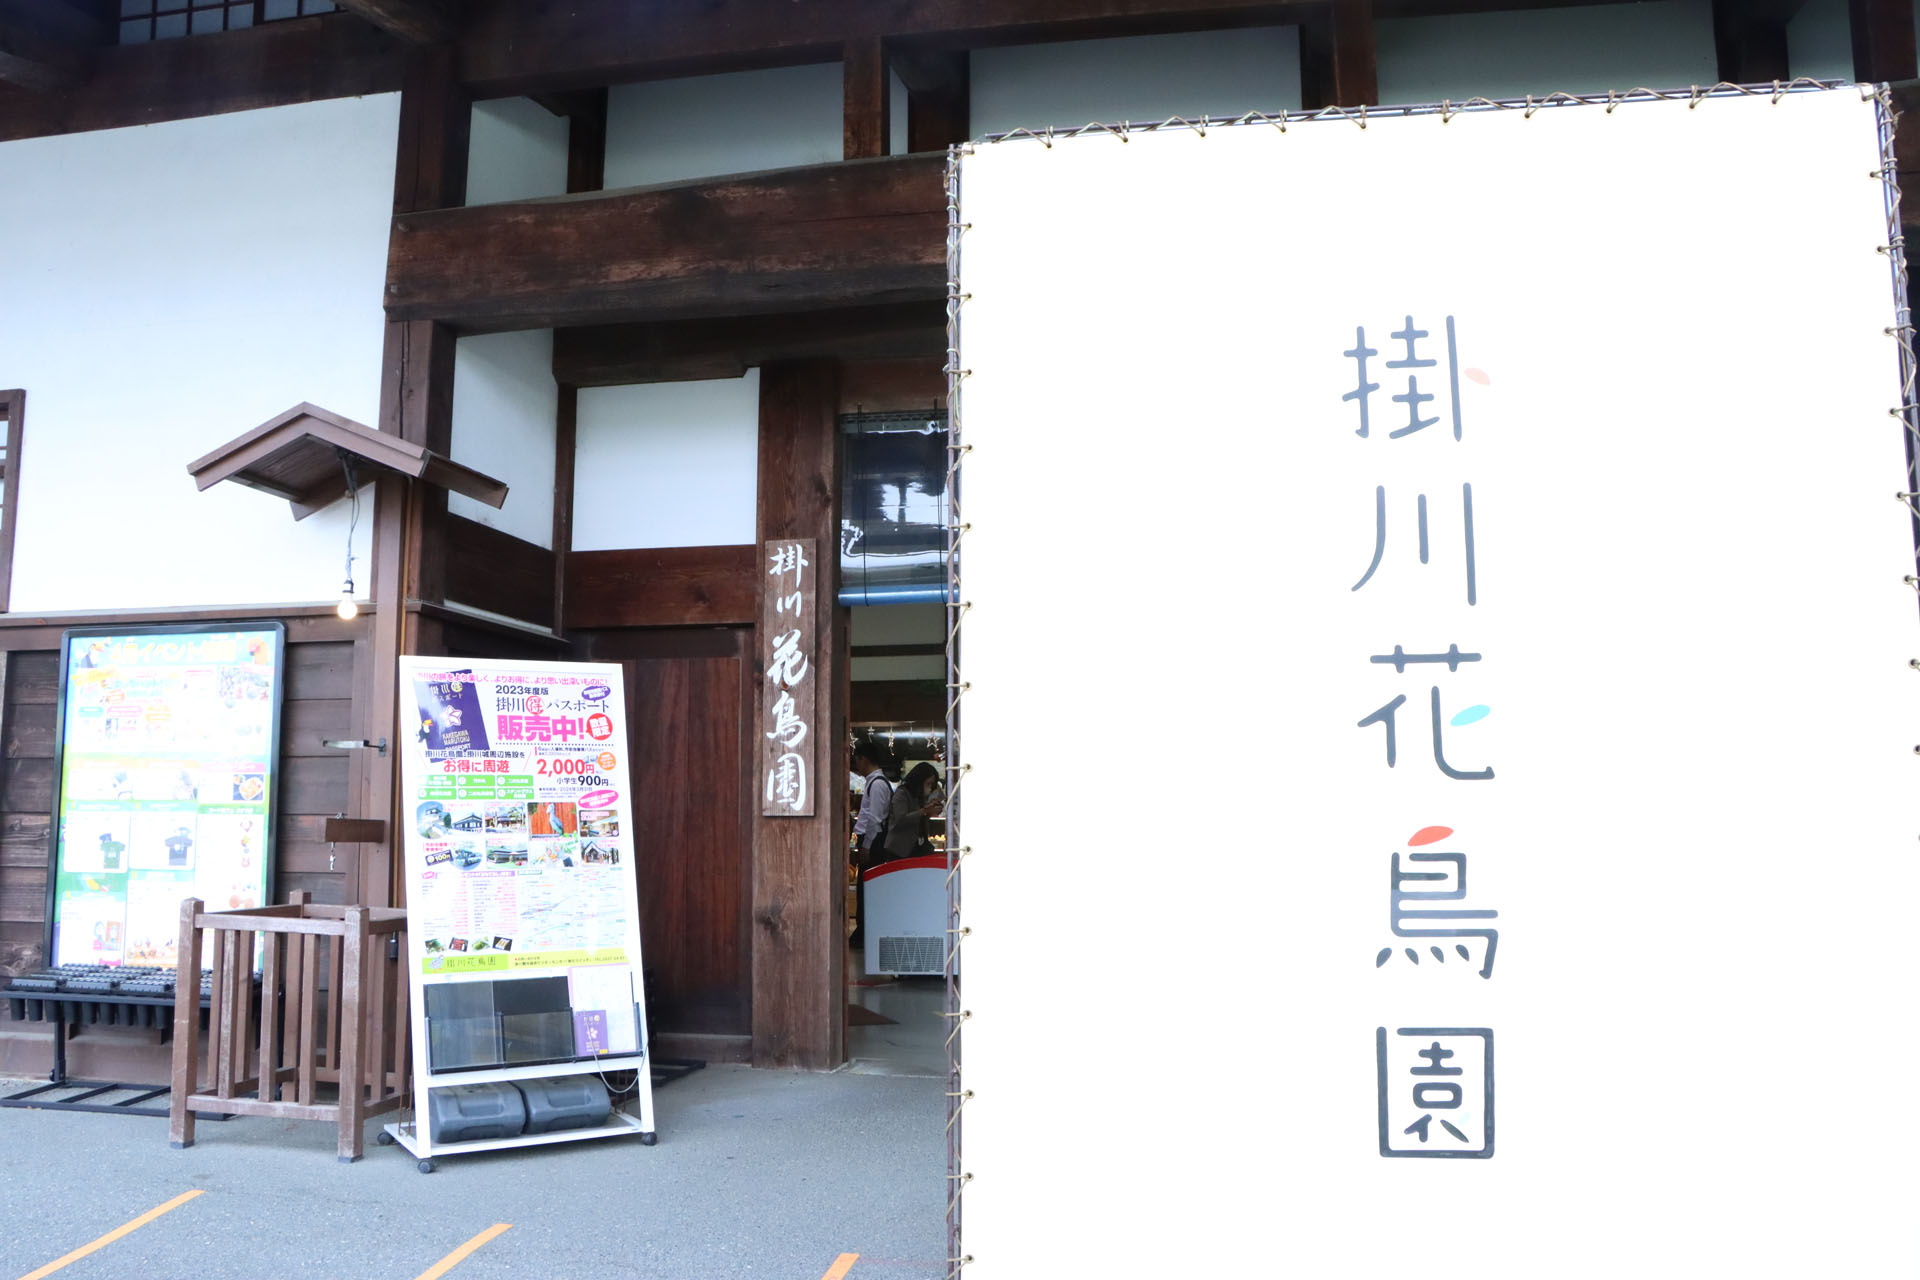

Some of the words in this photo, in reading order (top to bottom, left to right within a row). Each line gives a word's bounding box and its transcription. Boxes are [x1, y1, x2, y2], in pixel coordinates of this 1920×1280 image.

[766, 543, 808, 812] 掛川花鳥園
[495, 684, 549, 696] 2023年度版
[1342, 315, 1499, 1159] 掛川花鳥園
[443, 759, 511, 773] お得に周遊
[536, 758, 595, 777] 2,000円
